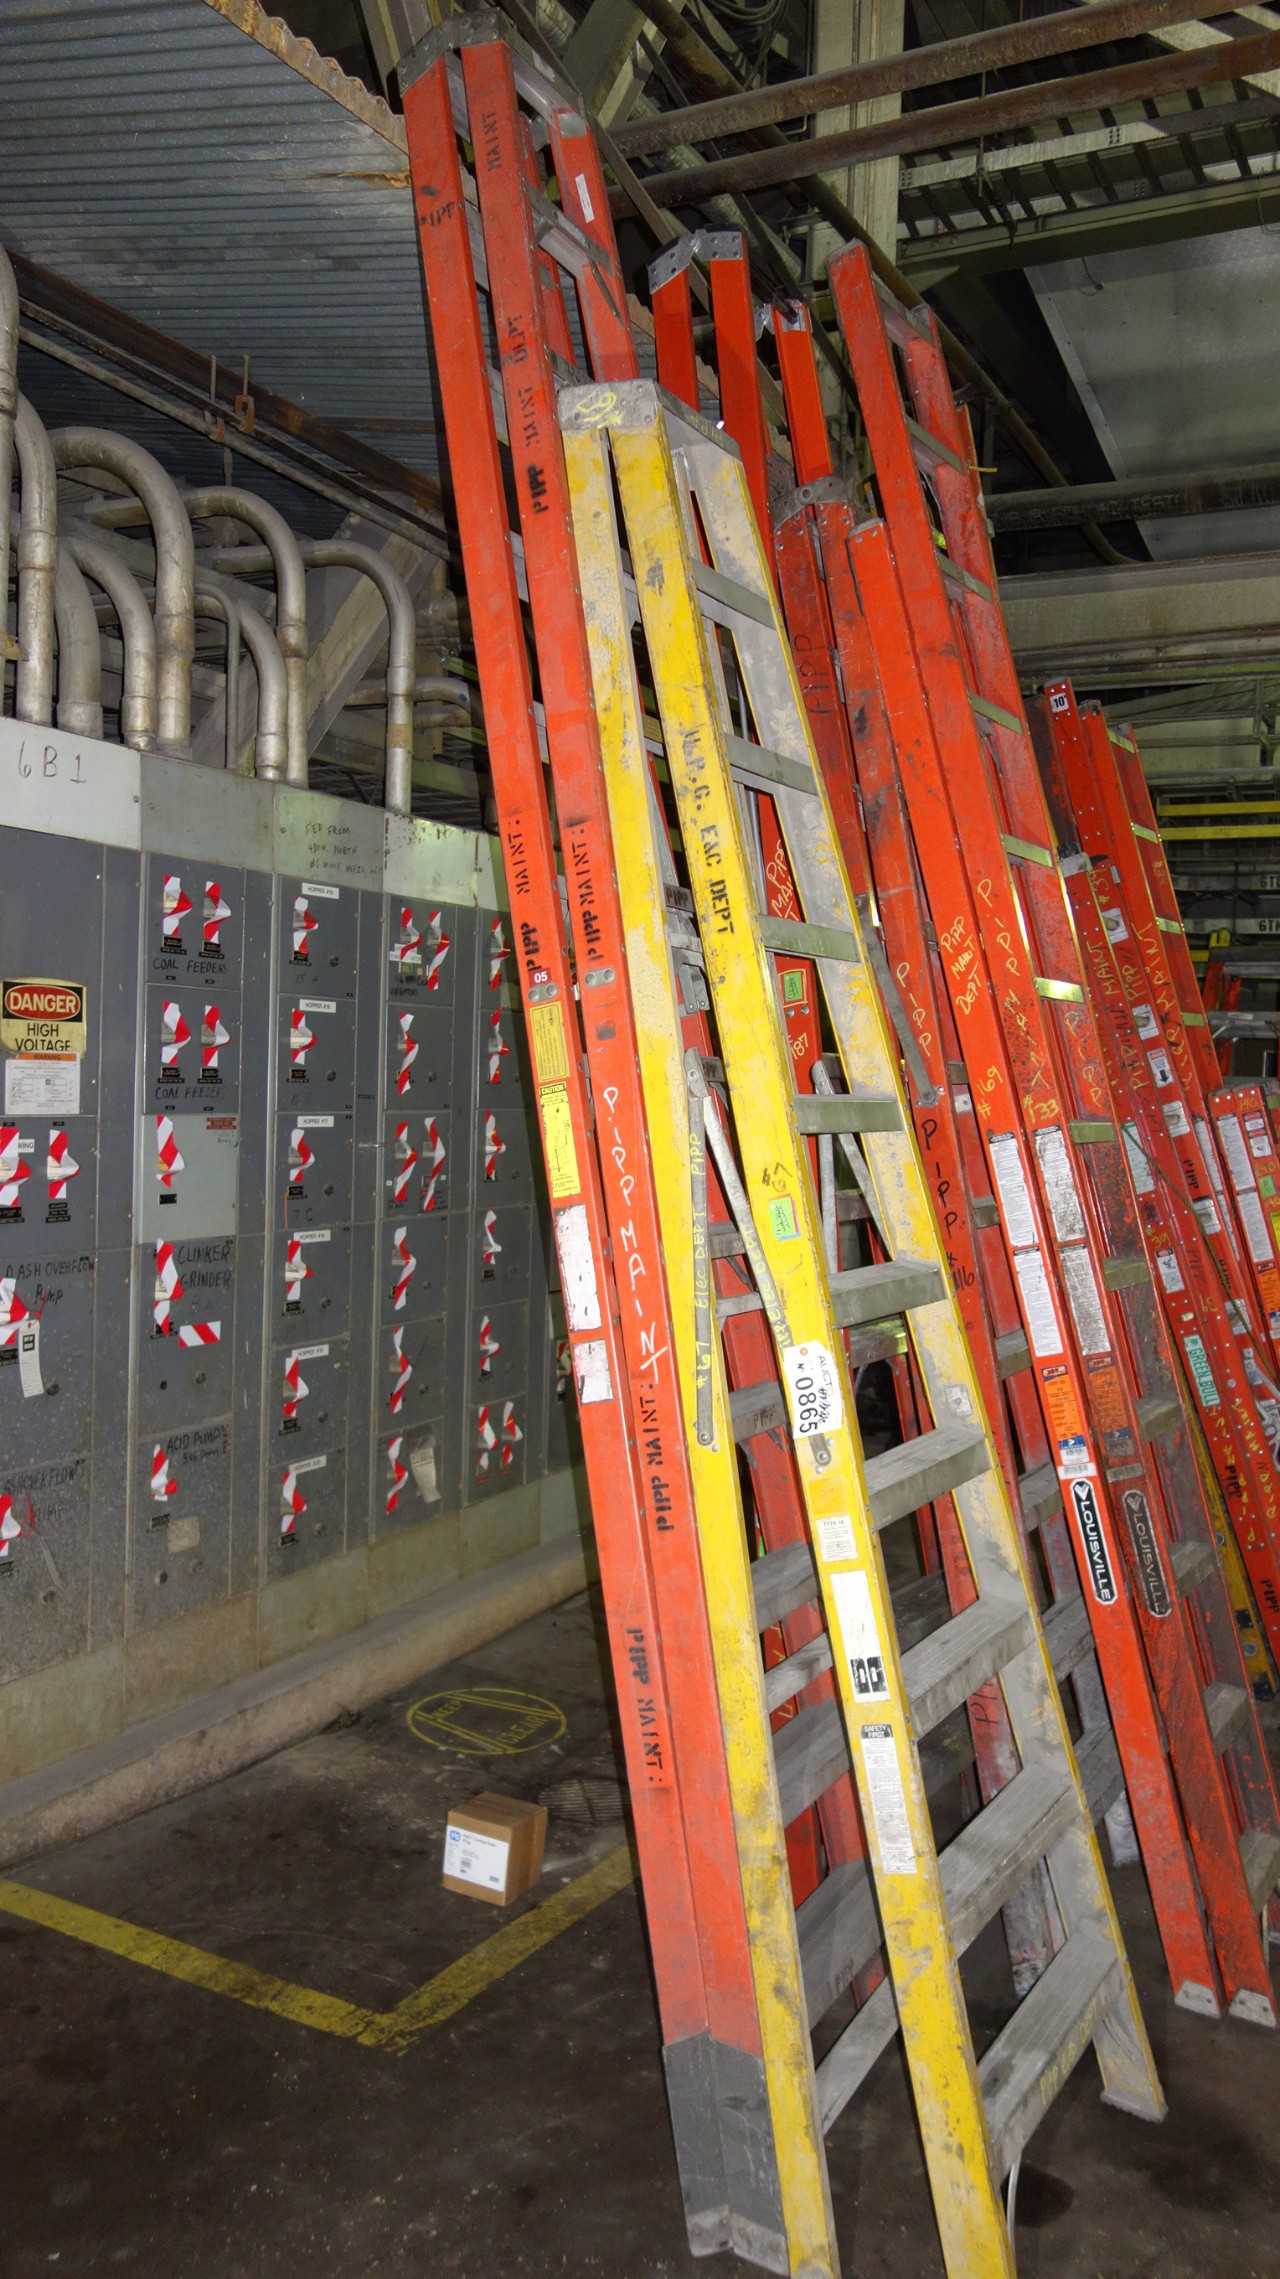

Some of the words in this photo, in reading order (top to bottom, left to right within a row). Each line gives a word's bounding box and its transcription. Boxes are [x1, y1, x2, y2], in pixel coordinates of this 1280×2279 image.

[528, 464, 549, 514] PIPP
[709, 879, 735, 934] DEPT
[520, 922, 543, 972] PIPP
[582, 910, 605, 960] PIPP
[941, 916, 965, 953] PIPP
[153, 958, 179, 970] COAL
[534, 972, 548, 983] 05
[956, 961, 982, 1016] DEPT
[9, 991, 76, 1014] DANGER
[27, 1023, 59, 1037] HIGH
[177, 1244, 232, 1264] CLINKER
[795, 1376, 818, 1434] 0865
[650, 1475, 676, 1532] PIPP
[1080, 1501, 1112, 1601] LOUISVILLE
